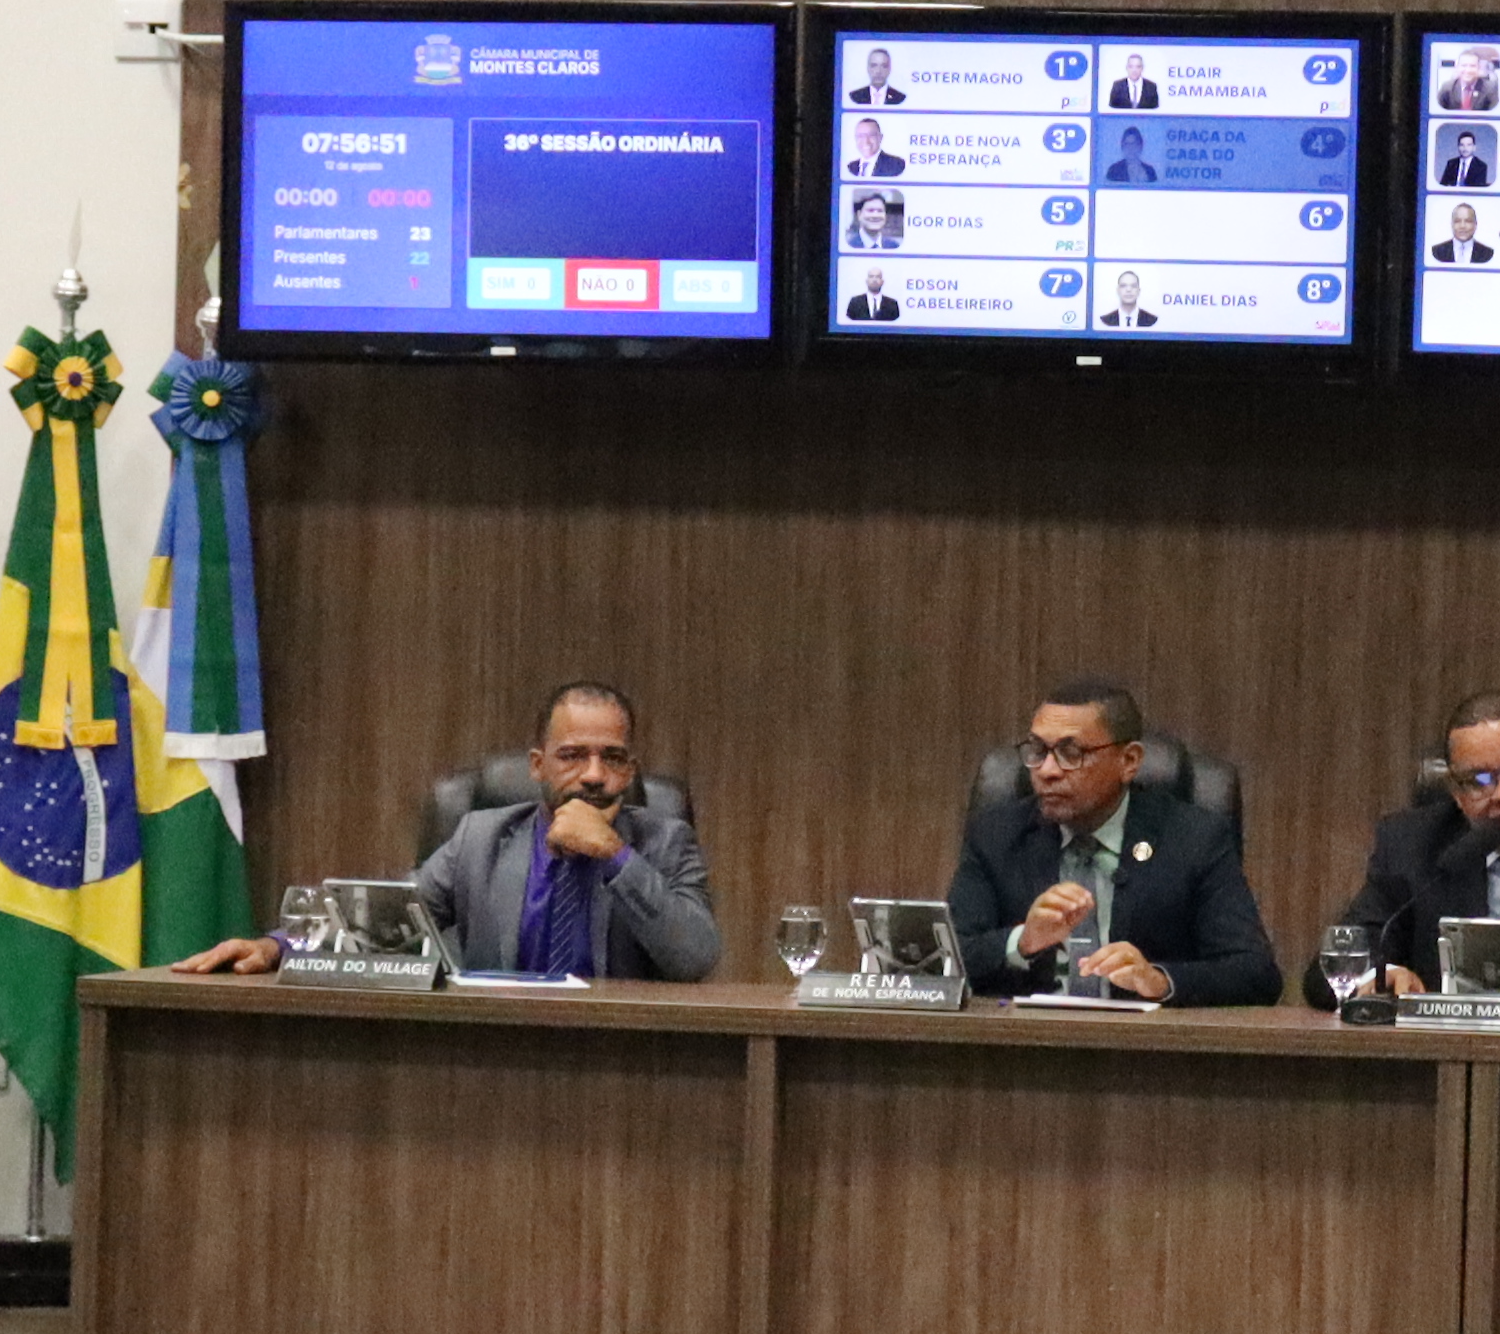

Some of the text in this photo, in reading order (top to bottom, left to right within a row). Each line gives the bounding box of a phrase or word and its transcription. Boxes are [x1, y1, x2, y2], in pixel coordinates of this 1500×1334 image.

[470, 47, 599, 60] CÂMARA MUNICIPAL DE
[470, 61, 599, 74] MONTES CLAROS
[912, 72, 1022, 84] SOTER MAGNO
[1168, 85, 1267, 98] SAMAMBAIA
[302, 133, 406, 154] 07:56:51
[541, 131, 615, 151] SESSÃO
[618, 132, 724, 153] ORDINÁRIA
[910, 135, 1021, 147] RENA DE NOVA
[1225, 131, 1246, 143] DA
[910, 153, 1001, 168] ESPERANÇA
[275, 188, 338, 206] 00:00
[368, 189, 432, 207] 00:00
[908, 216, 983, 228] IGOR DIAS
[274, 225, 431, 241] Parlamentares 23
[274, 250, 430, 265] Presentes 22
[274, 274, 341, 288] Ausentes
[582, 275, 634, 291] NÃO 0
[906, 279, 958, 290] EDSON
[906, 297, 1012, 310] CABELEIREIRO
[1162, 294, 1257, 307] DANIEL DIAS
[284, 958, 431, 975] AILTON DO VILLAGE
[812, 988, 945, 1003] DE NOVA ESPERANÇA
[1416, 1003, 1472, 1016] JUNIOR
